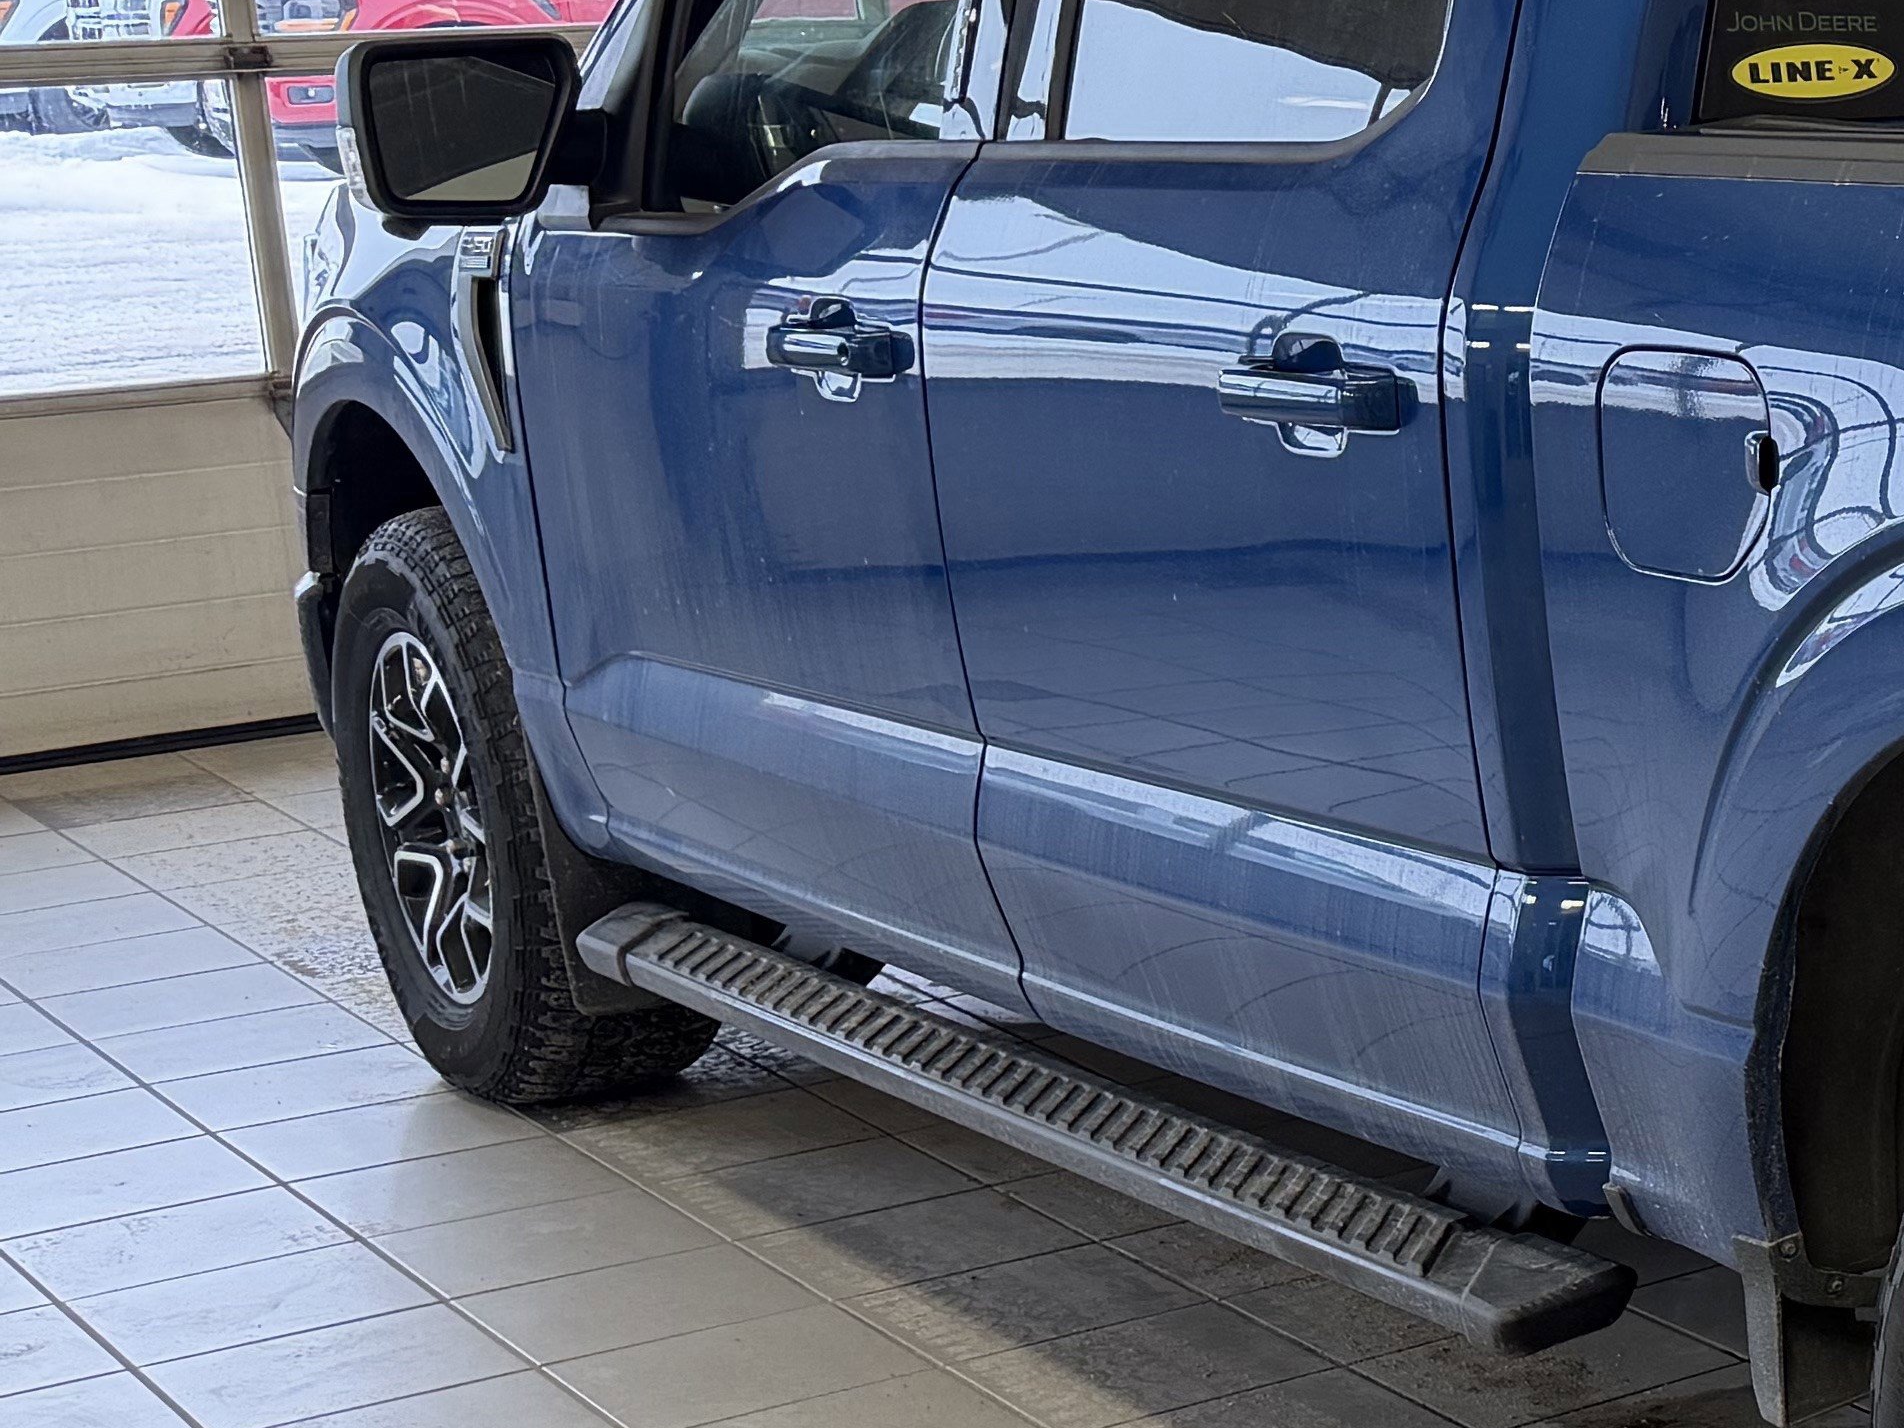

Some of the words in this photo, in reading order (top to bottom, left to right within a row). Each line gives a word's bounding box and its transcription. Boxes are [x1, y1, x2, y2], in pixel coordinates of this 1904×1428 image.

[1727, 11, 1794, 32] JOHN
[1798, 11, 1878, 33] DEERE
[1748, 57, 1878, 84] LINE-X
